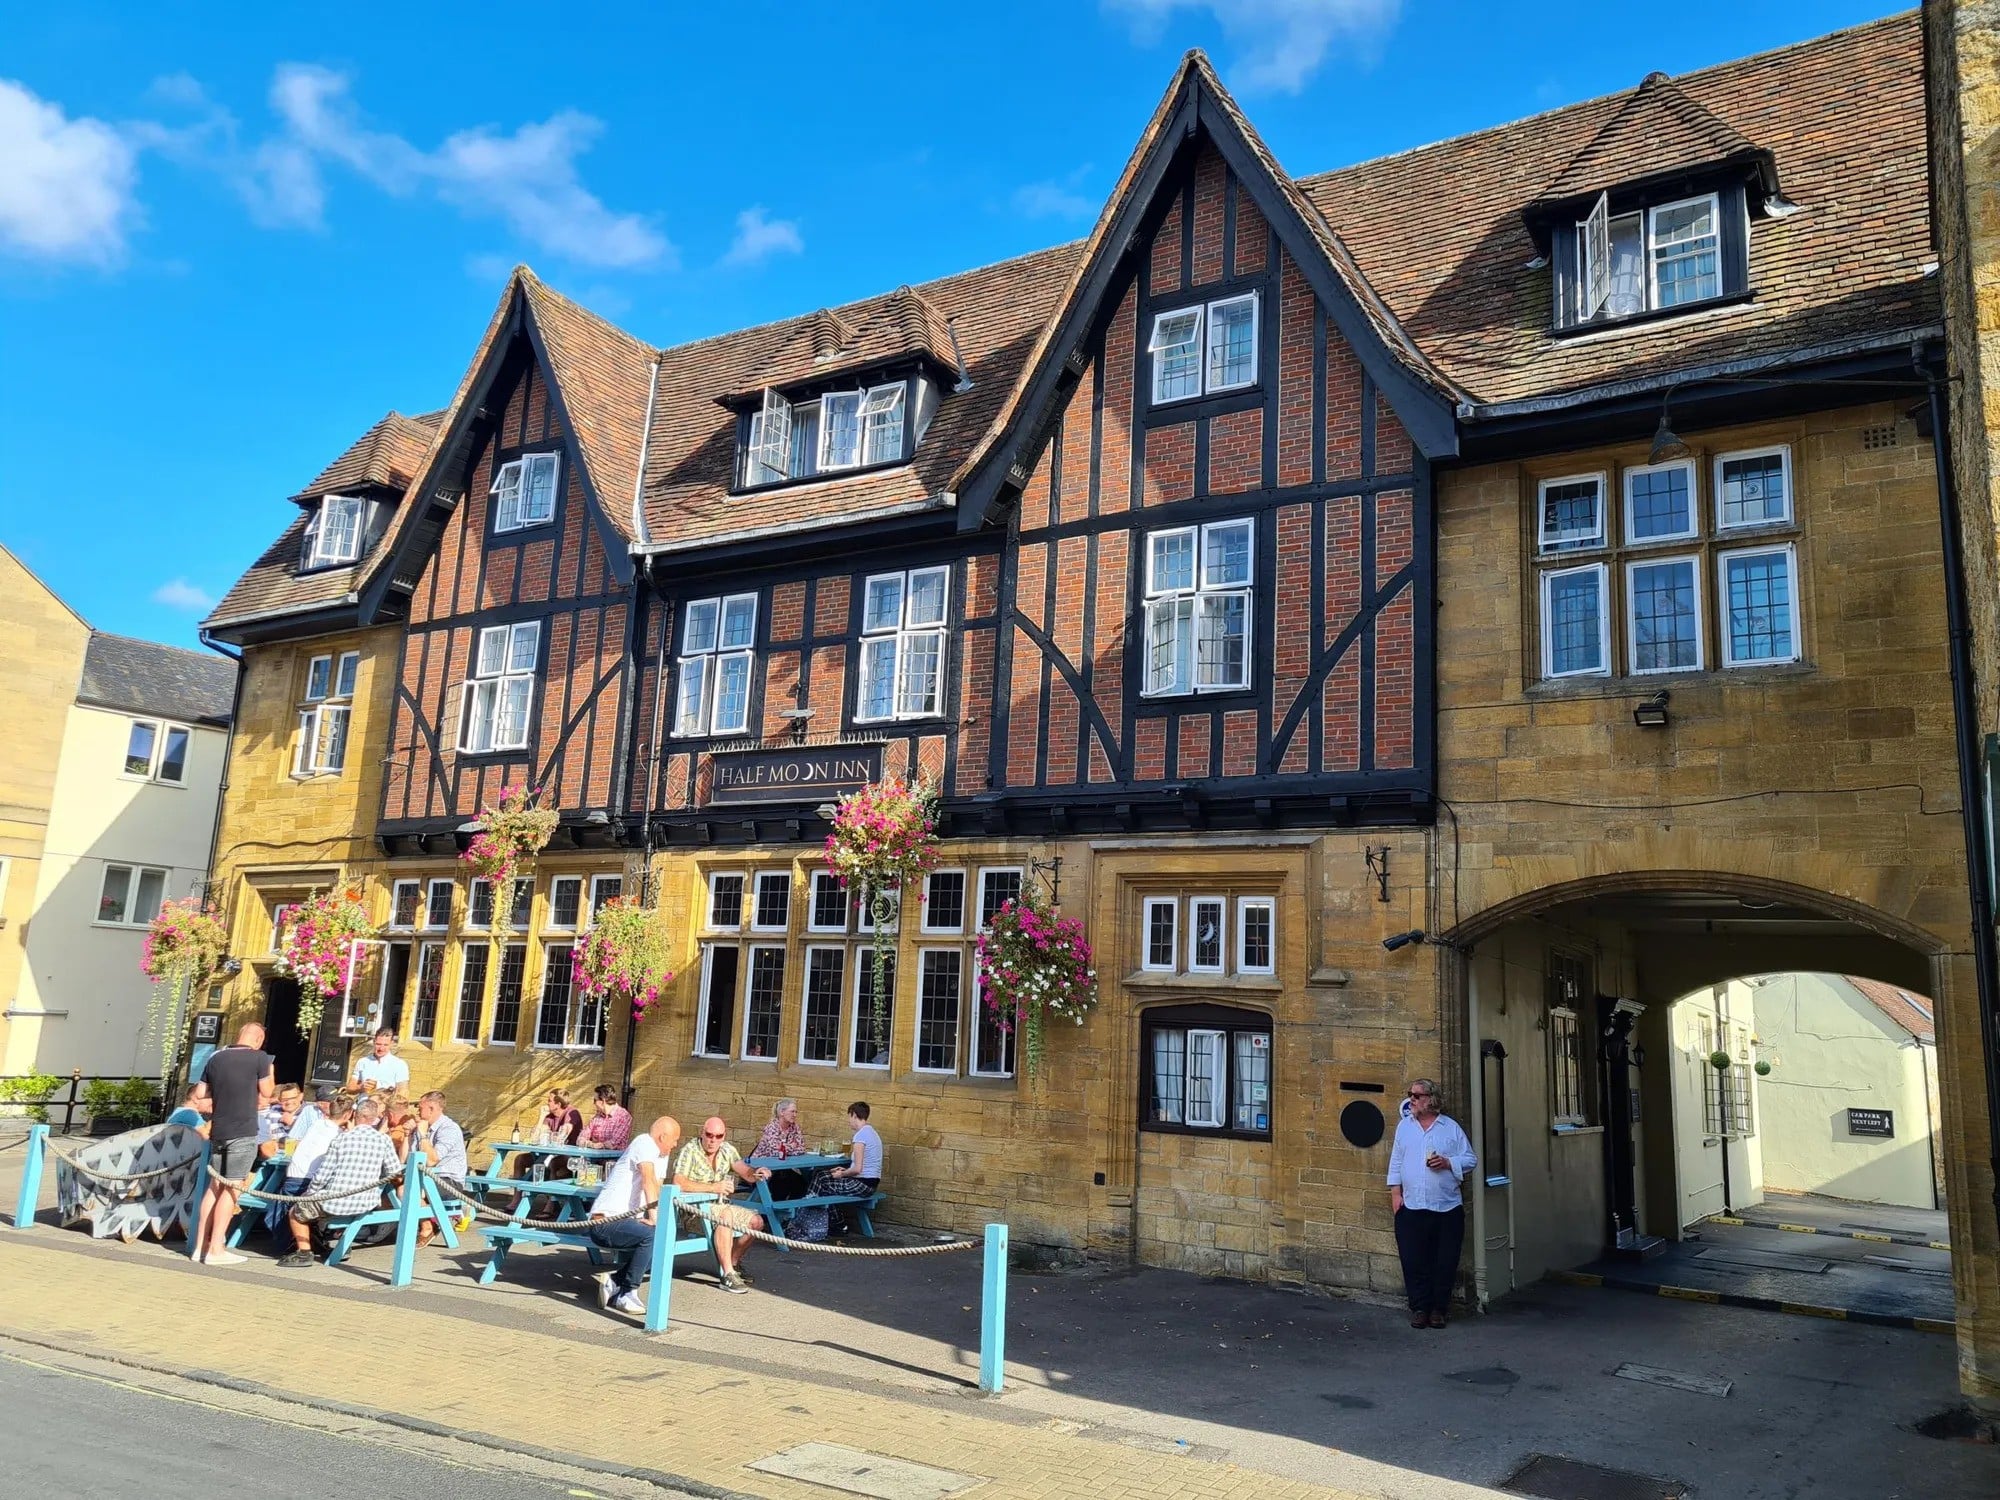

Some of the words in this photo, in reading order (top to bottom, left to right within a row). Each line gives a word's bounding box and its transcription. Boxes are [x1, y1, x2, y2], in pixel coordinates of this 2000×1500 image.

[721, 765, 765, 785] HALF
[834, 759, 871, 780] INN
[322, 1047, 341, 1057] FOOD
